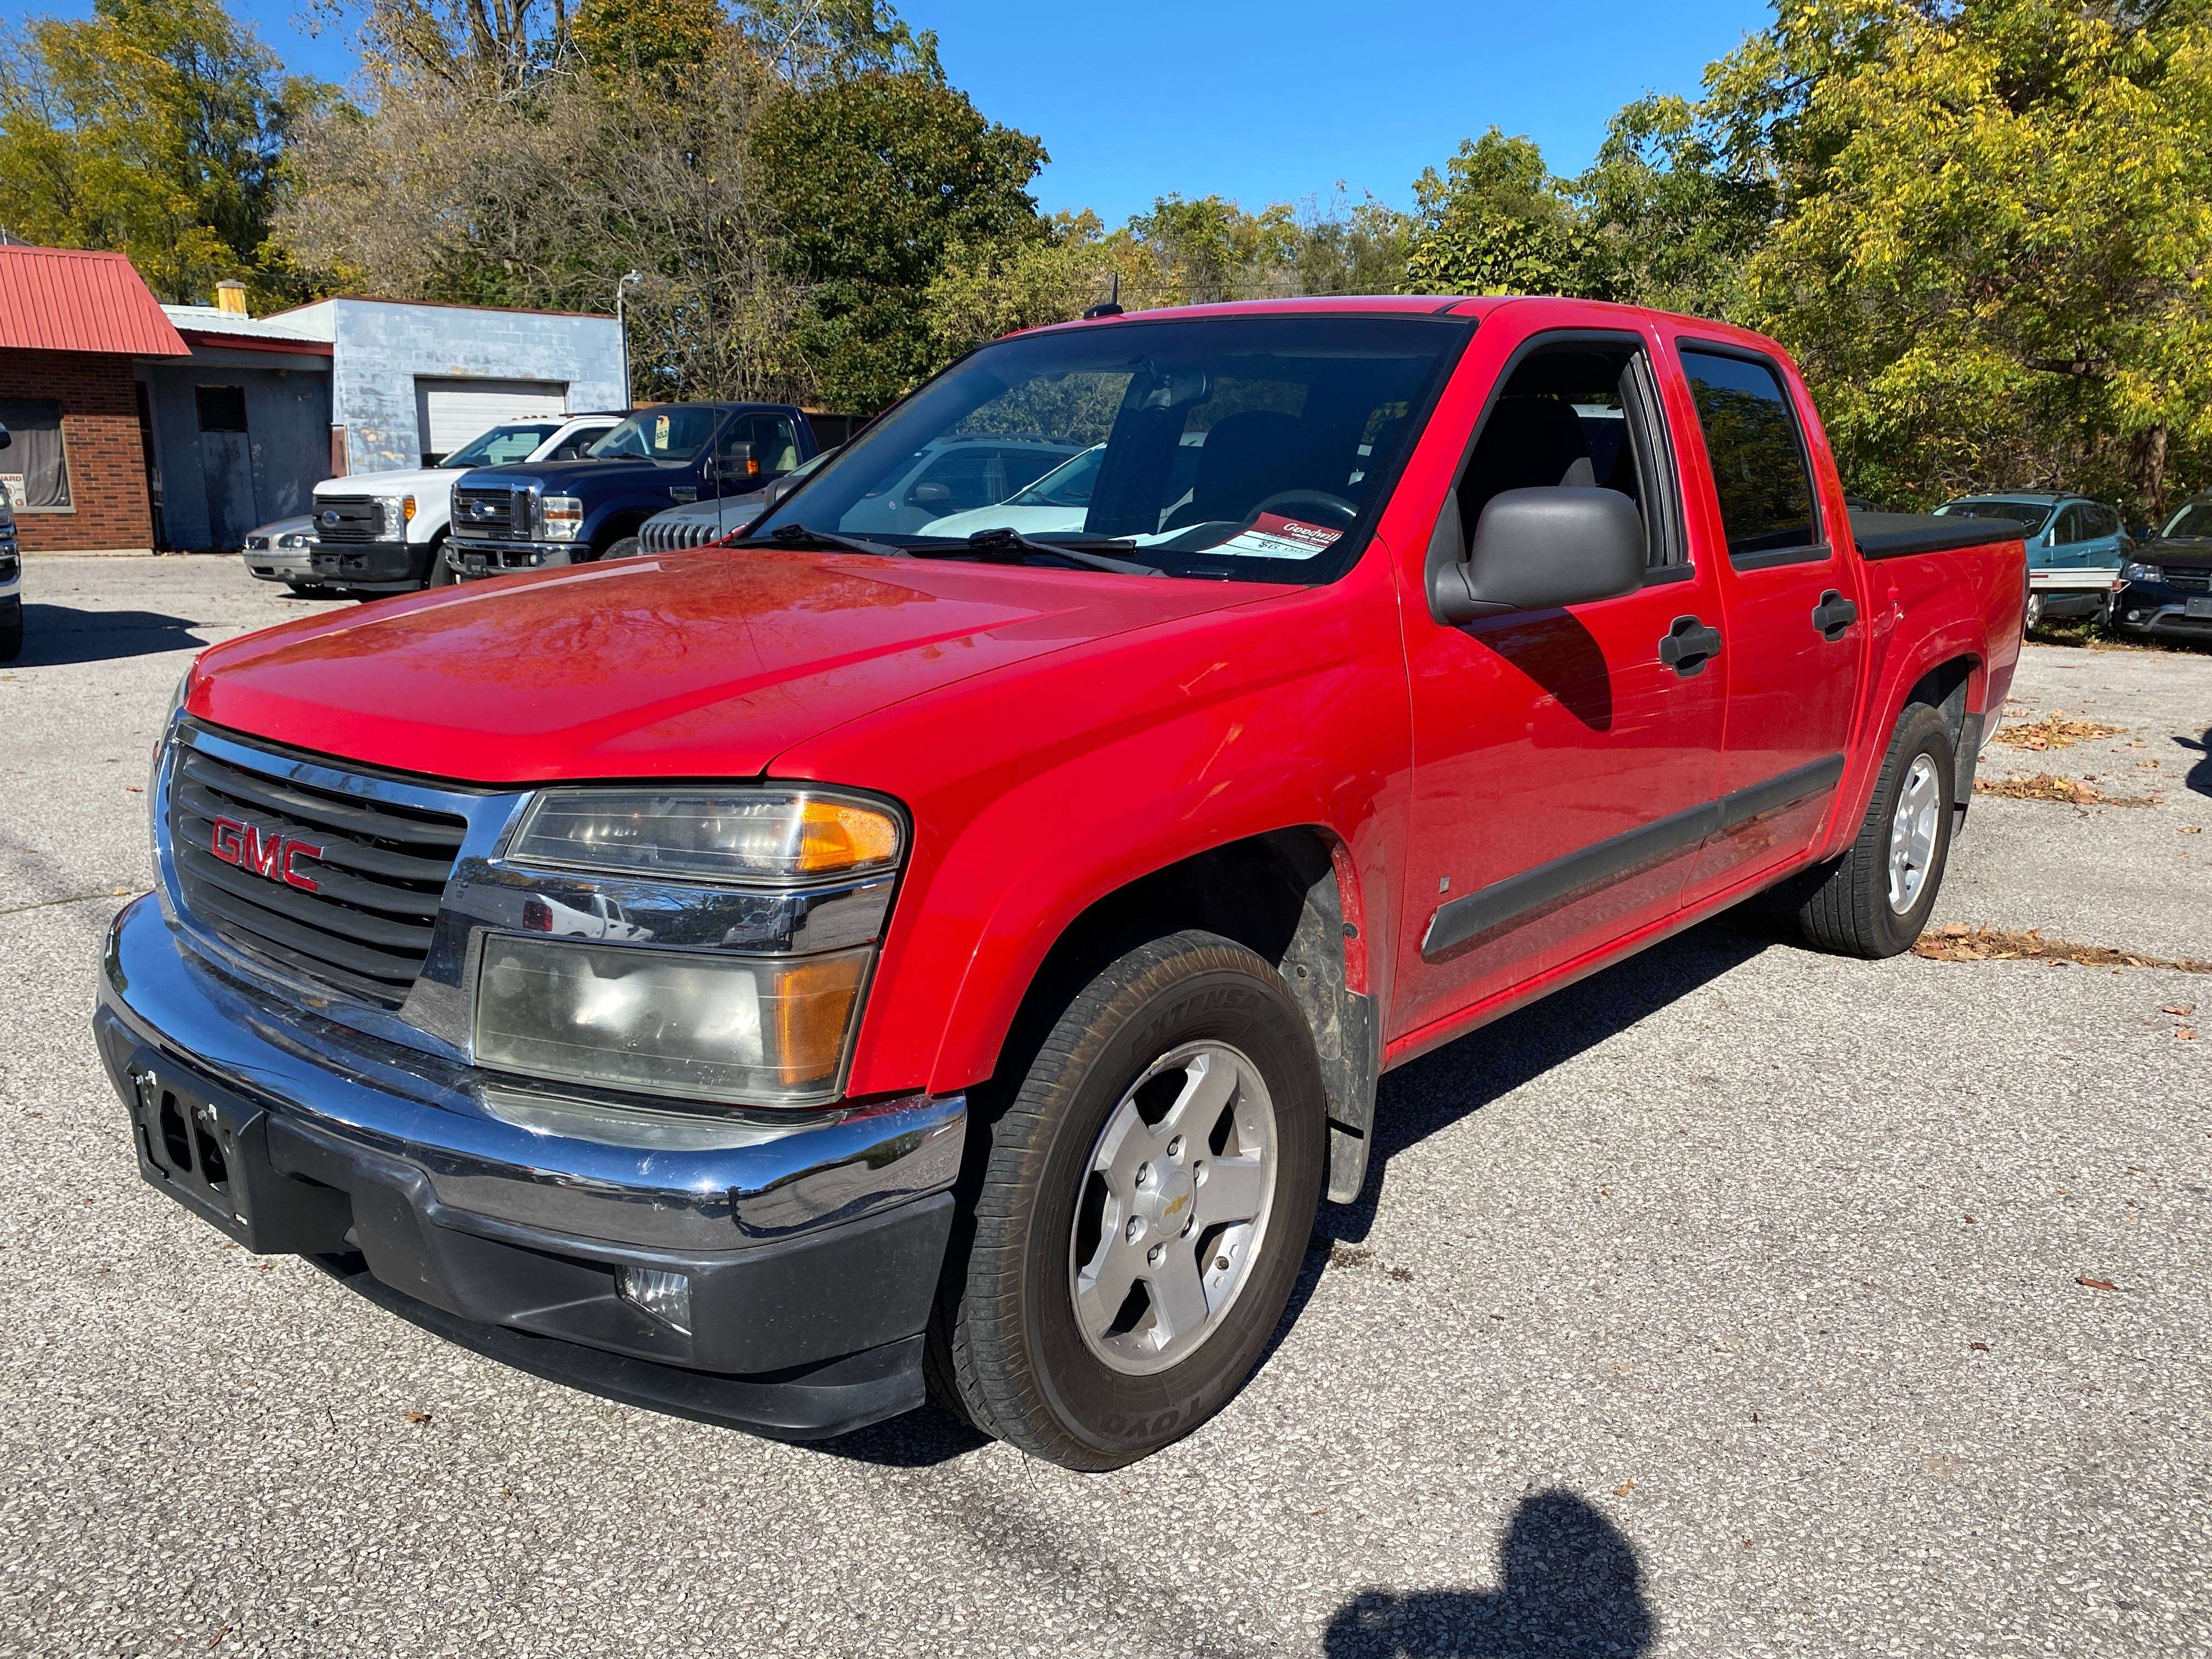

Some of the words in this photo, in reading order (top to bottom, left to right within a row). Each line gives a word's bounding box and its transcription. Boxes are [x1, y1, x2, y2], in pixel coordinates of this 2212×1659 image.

[656, 430, 668, 439] SOLD
[1283, 523, 1342, 541] Goodwill
[212, 813, 326, 894] GMC
[1098, 1396, 1207, 1438] TOYO
